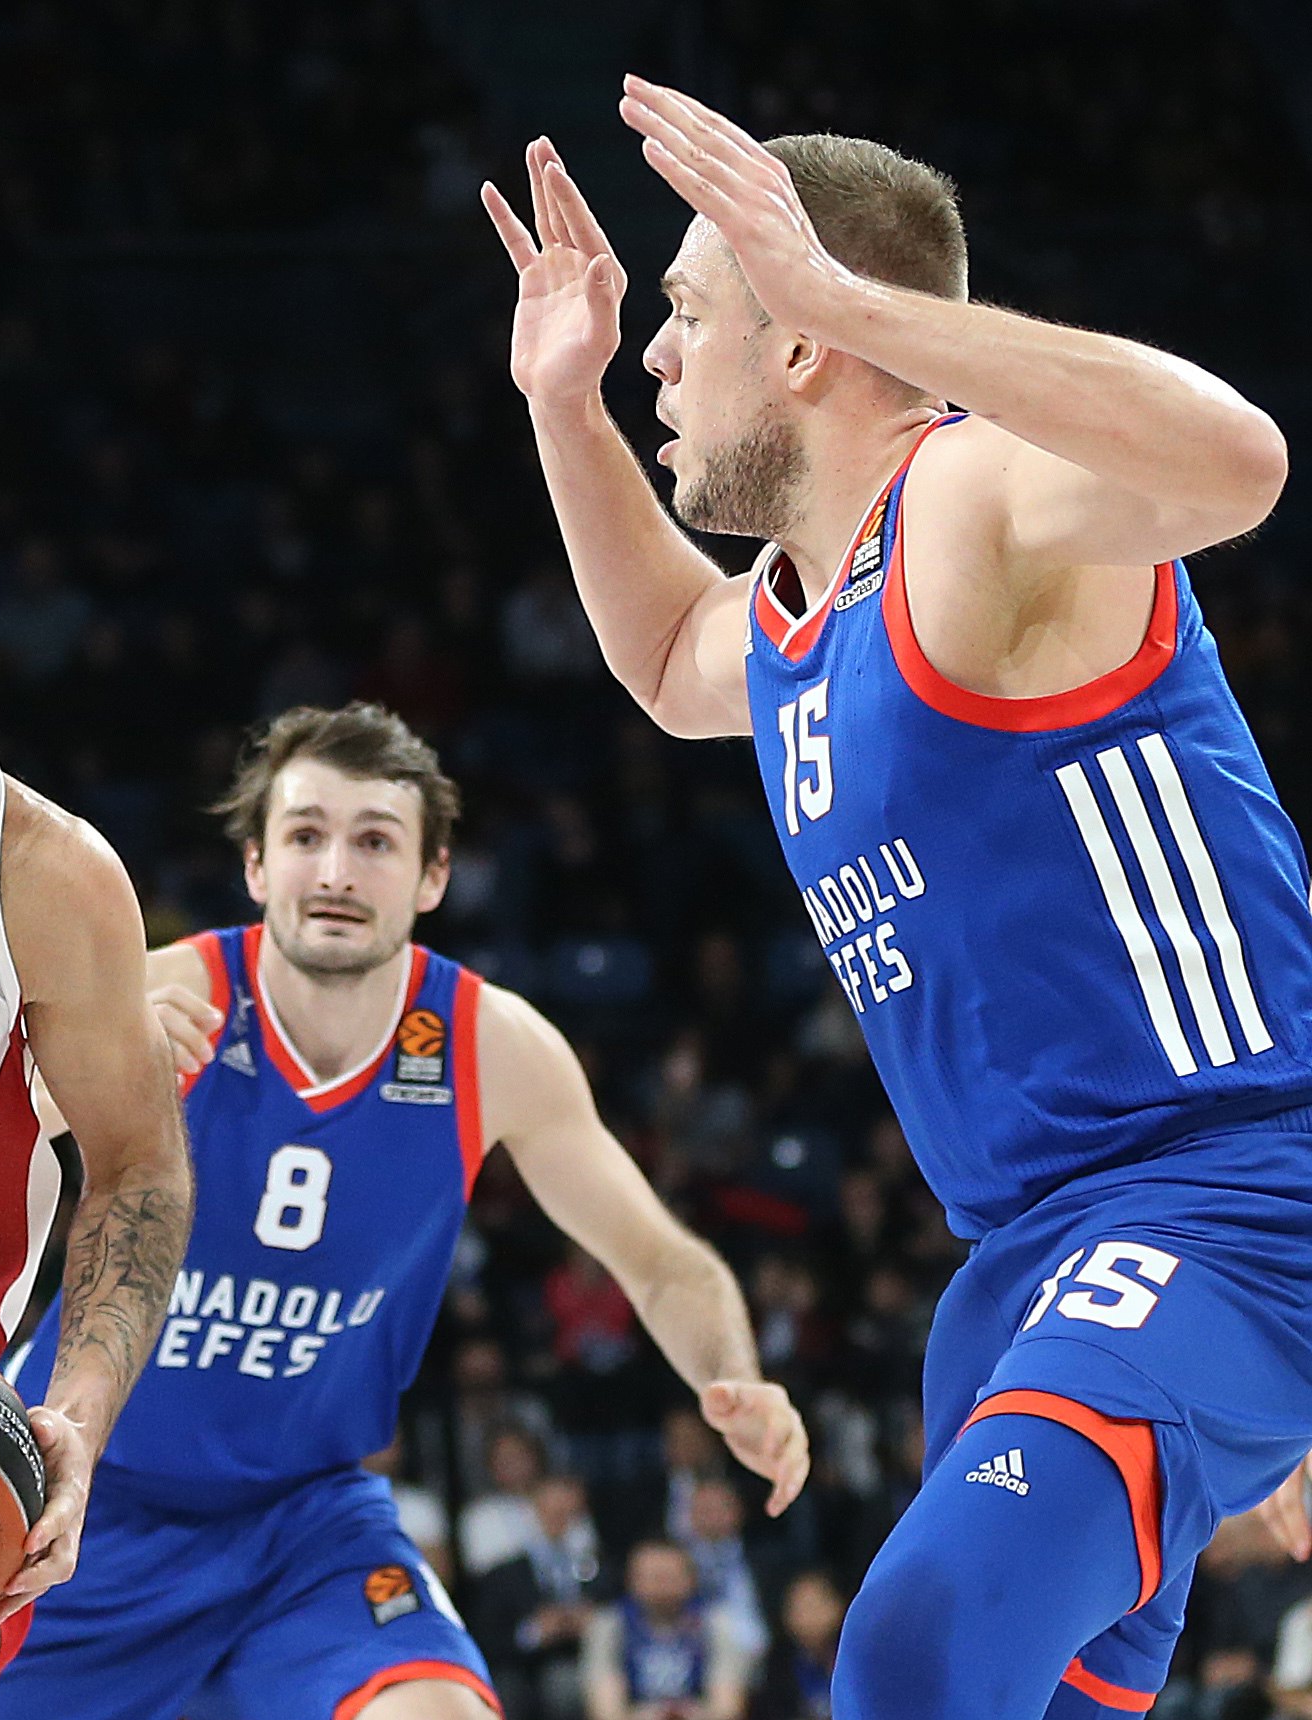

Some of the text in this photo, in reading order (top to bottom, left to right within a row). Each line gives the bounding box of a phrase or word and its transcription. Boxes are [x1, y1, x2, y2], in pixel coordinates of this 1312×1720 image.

[777, 677, 835, 837] 15
[253, 1144, 333, 1252] 8
[1023, 1240, 1181, 1331] 15
[156, 1317, 327, 1379] EFES
[965, 1469, 1030, 1496] adidas
